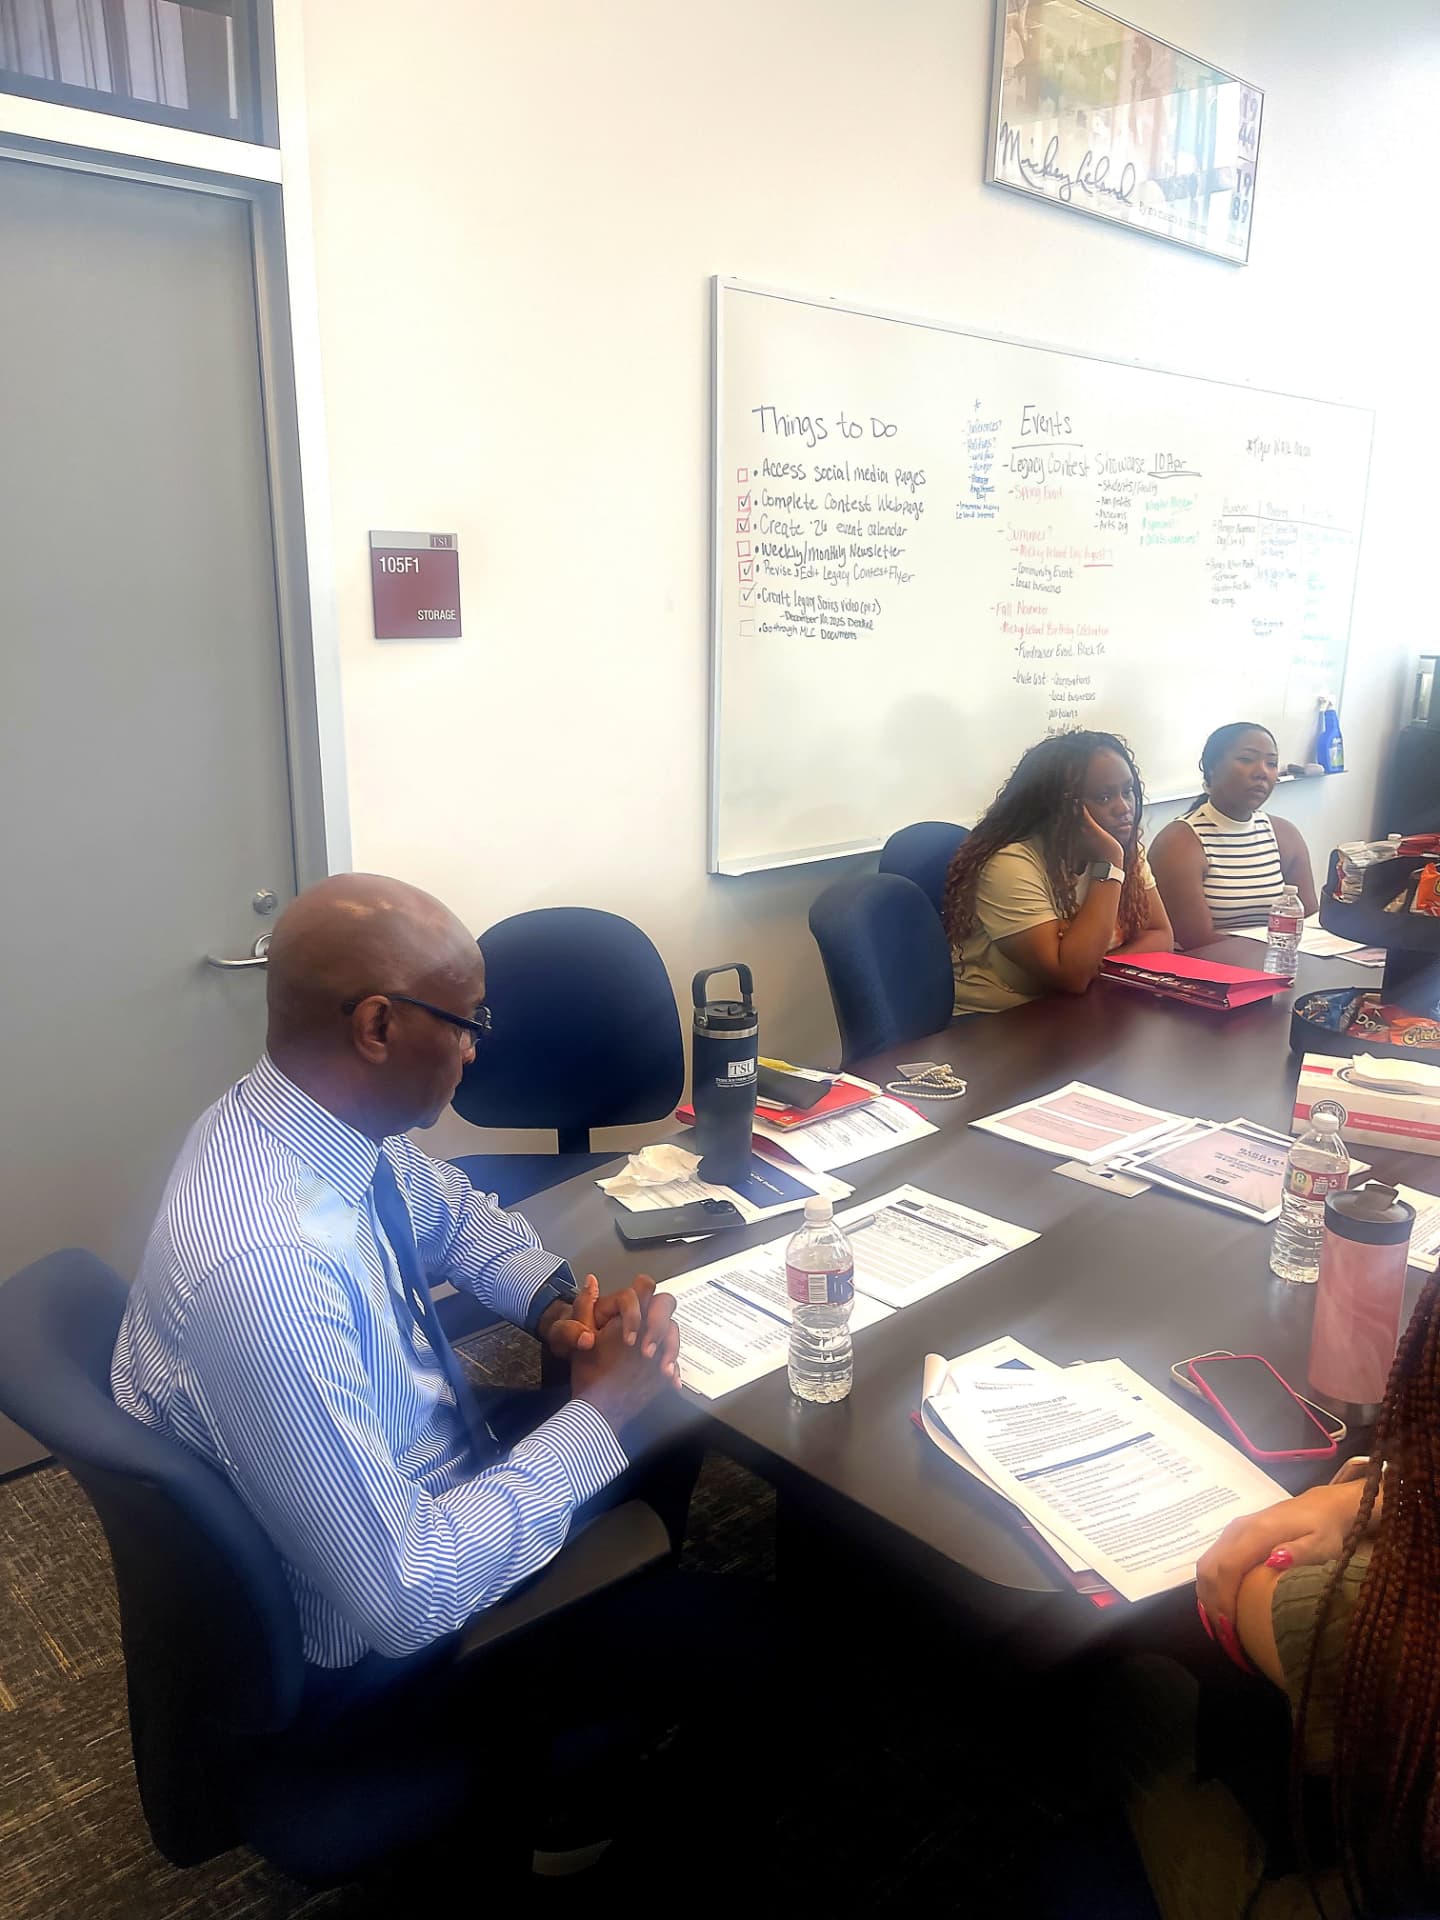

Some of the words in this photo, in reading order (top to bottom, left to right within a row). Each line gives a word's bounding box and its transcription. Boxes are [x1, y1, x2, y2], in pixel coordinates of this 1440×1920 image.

[752, 405, 828, 448] Things
[836, 411, 863, 439] to
[870, 417, 898, 438] Do
[1021, 405, 1072, 436] Events
[762, 458, 807, 481] Access
[1010, 453, 1045, 484] Legacy
[761, 488, 818, 514] Complete
[824, 492, 871, 513] Contest
[760, 512, 805, 539] Create
[835, 520, 863, 537] event
[849, 543, 907, 560] Newsletter
[379, 556, 420, 574] 105F1
[417, 609, 457, 621] STORAGE
[730, 1061, 754, 1076] TSU
